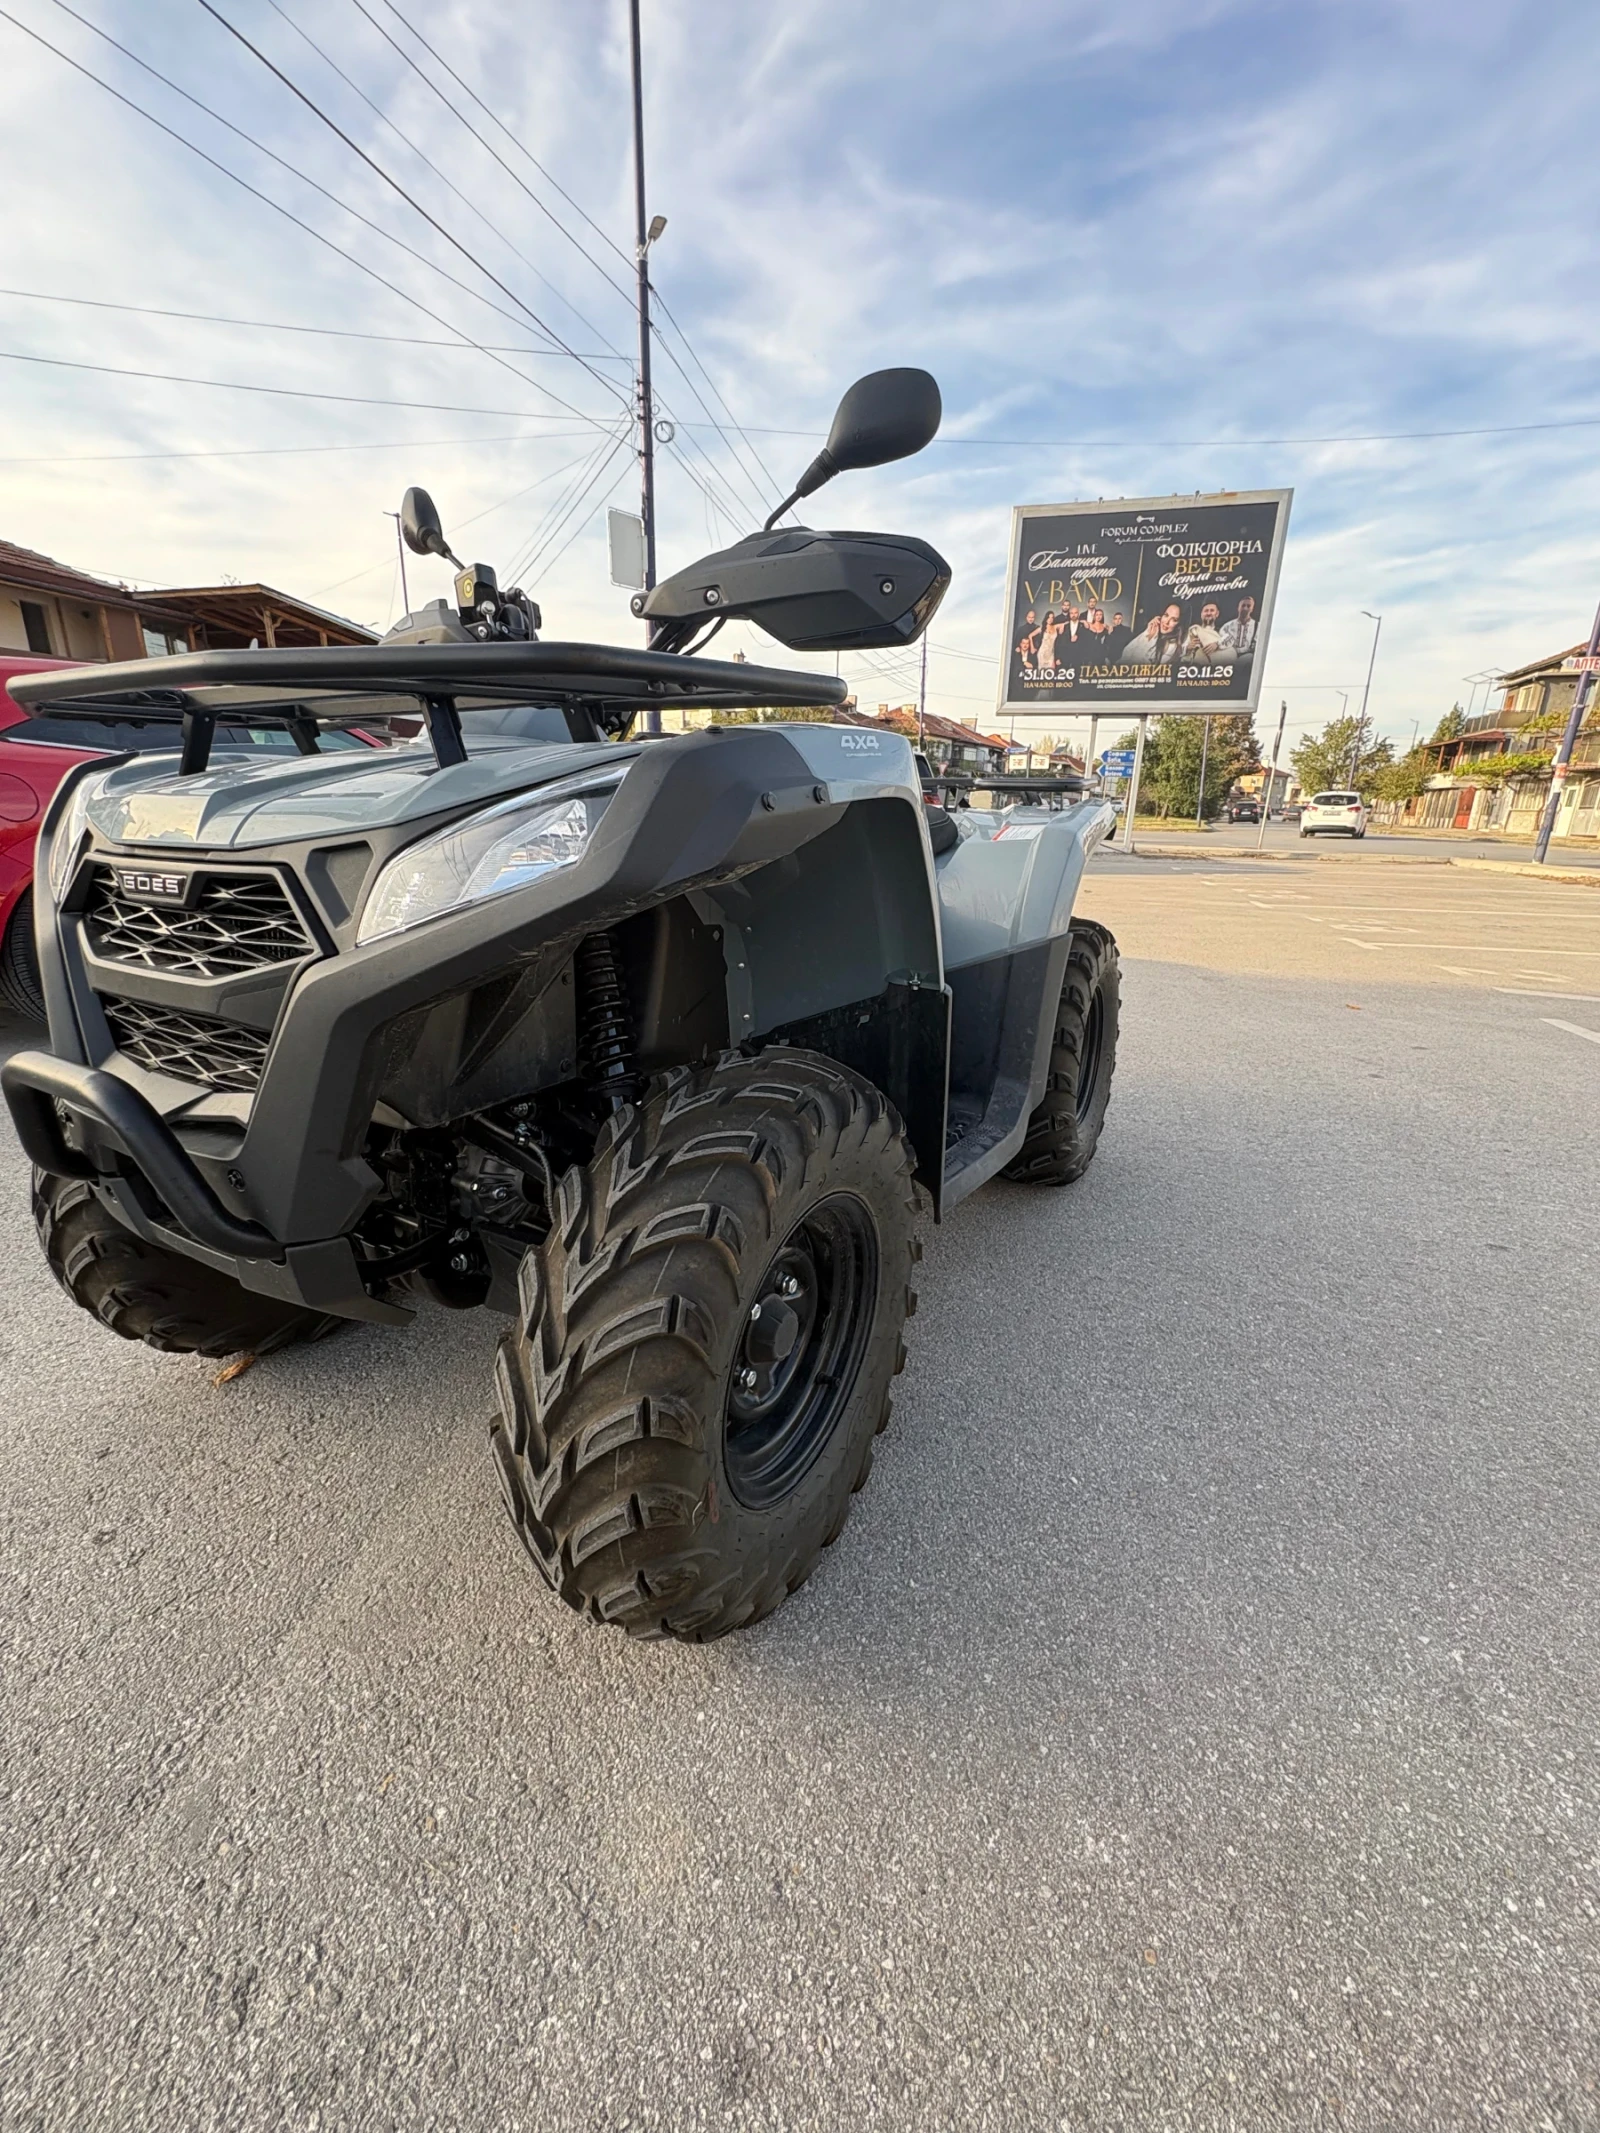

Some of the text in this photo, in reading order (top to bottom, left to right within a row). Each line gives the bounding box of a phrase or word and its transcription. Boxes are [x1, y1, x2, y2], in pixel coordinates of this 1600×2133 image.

[1101, 523, 1188, 537] FORUM COMPLEX
[1077, 543, 1098, 555] LIVE
[1156, 540, 1263, 558] ФОЛКЛОРНА
[1028, 547, 1109, 572] Балканско
[1174, 555, 1242, 575] ВЕЧЕР
[1070, 567, 1117, 586] парти
[1158, 571, 1211, 587] Светла
[1024, 578, 1122, 605] V-BAND
[1172, 575, 1249, 601] Дукатева
[1023, 668, 1076, 681] 31.10.26
[1079, 664, 1173, 678] ПАЗАРДЖИК
[1177, 665, 1234, 679] 20.11.26
[841, 735, 880, 750] 4X4
[123, 875, 179, 894] GOES
